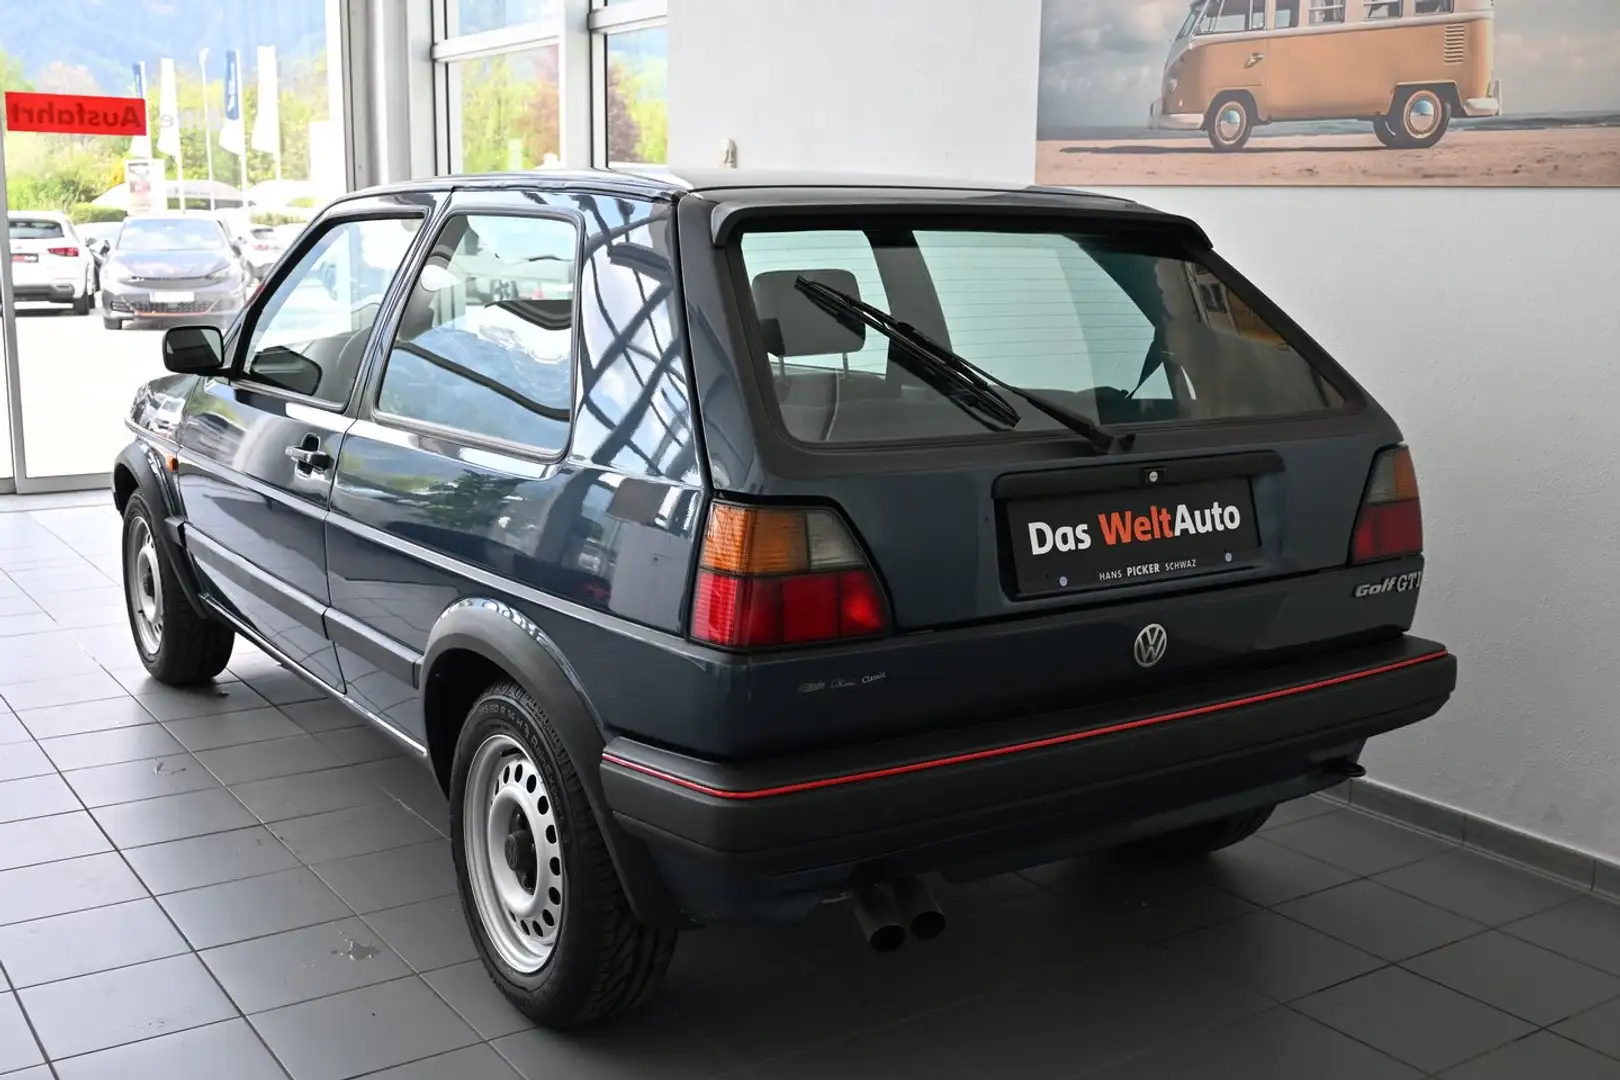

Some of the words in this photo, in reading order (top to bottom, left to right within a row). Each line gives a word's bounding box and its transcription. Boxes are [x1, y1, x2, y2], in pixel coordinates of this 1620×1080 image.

[1028, 521, 1092, 556] Das
[1097, 501, 1241, 546] WeltAuto
[1099, 570, 1123, 581] HANS
[1126, 563, 1161, 577] PICKER
[1164, 559, 1197, 572] SCHWAZ
[1354, 576, 1397, 598] Golf
[1396, 571, 1423, 593] GTI
[861, 671, 887, 684] Classic
